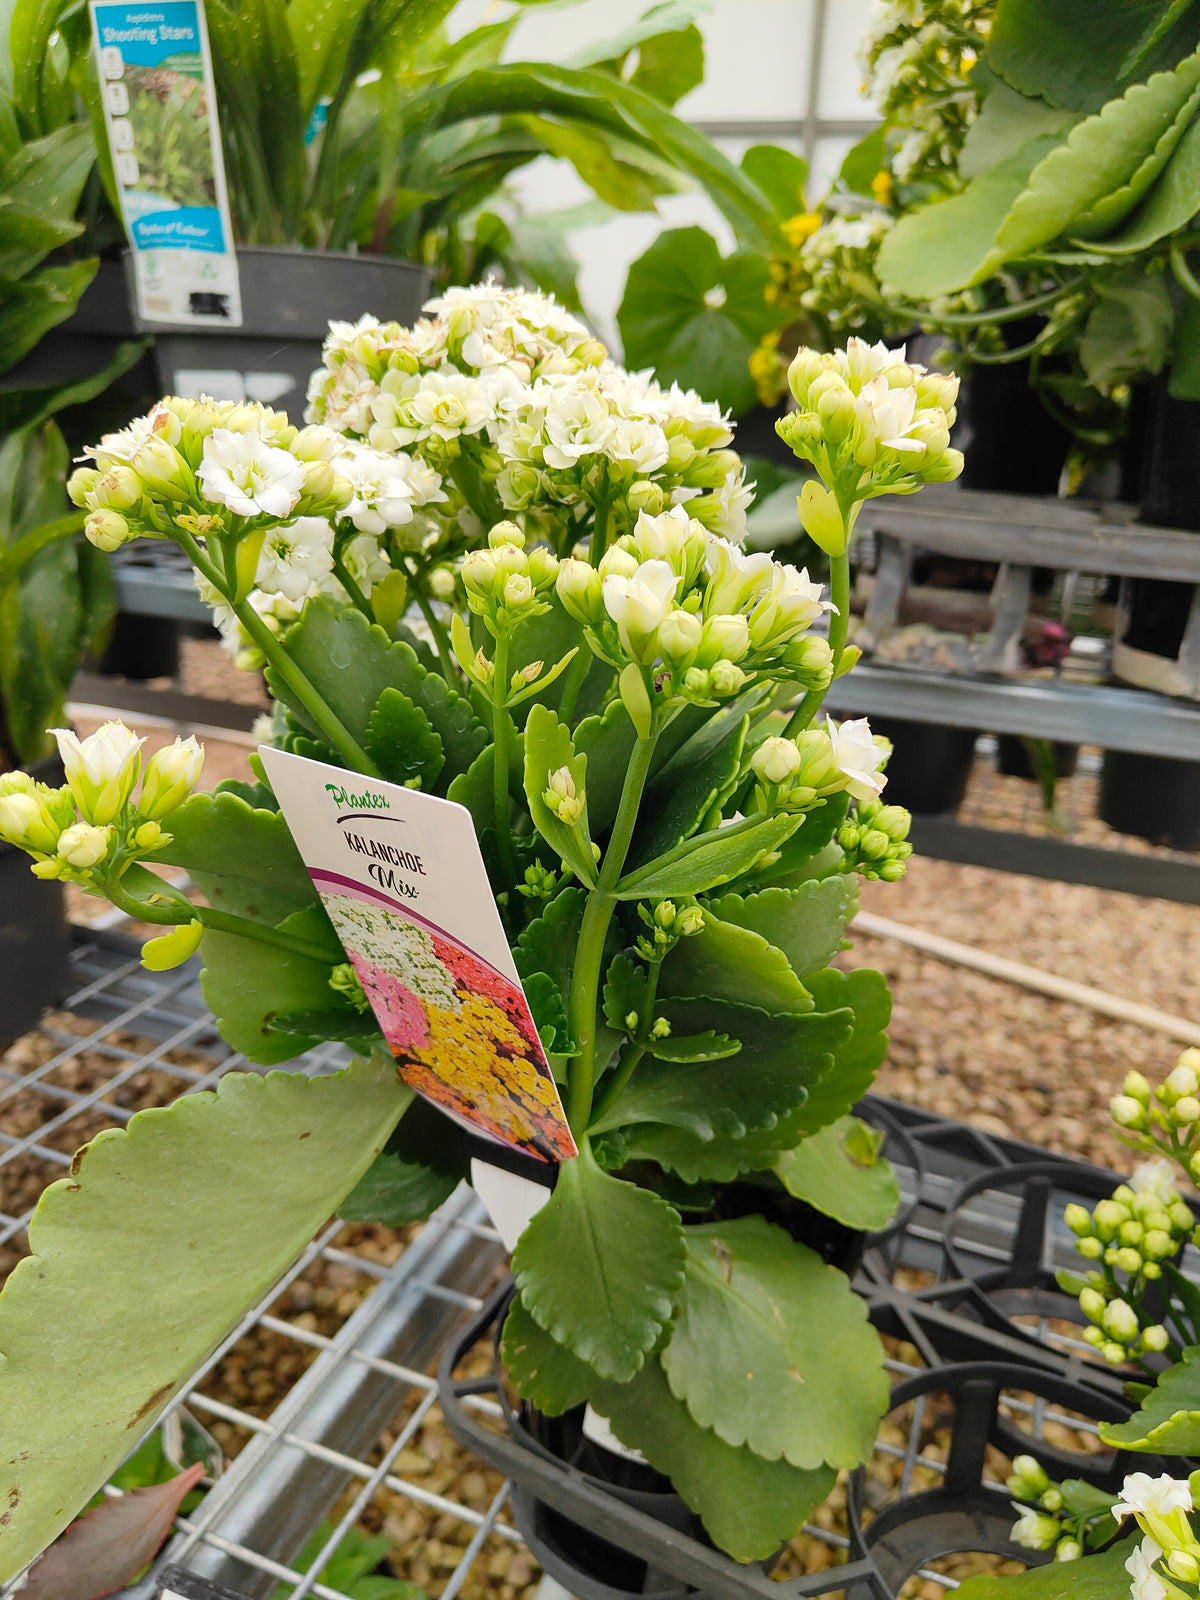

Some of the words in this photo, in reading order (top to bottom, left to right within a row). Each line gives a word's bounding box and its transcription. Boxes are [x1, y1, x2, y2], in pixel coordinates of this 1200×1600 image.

[102, 26, 158, 45] Shooting
[159, 24, 195, 41] Stars
[325, 783, 390, 809] Plantex
[343, 830, 427, 876] KALANCHOE
[368, 863, 420, 899] Mix
